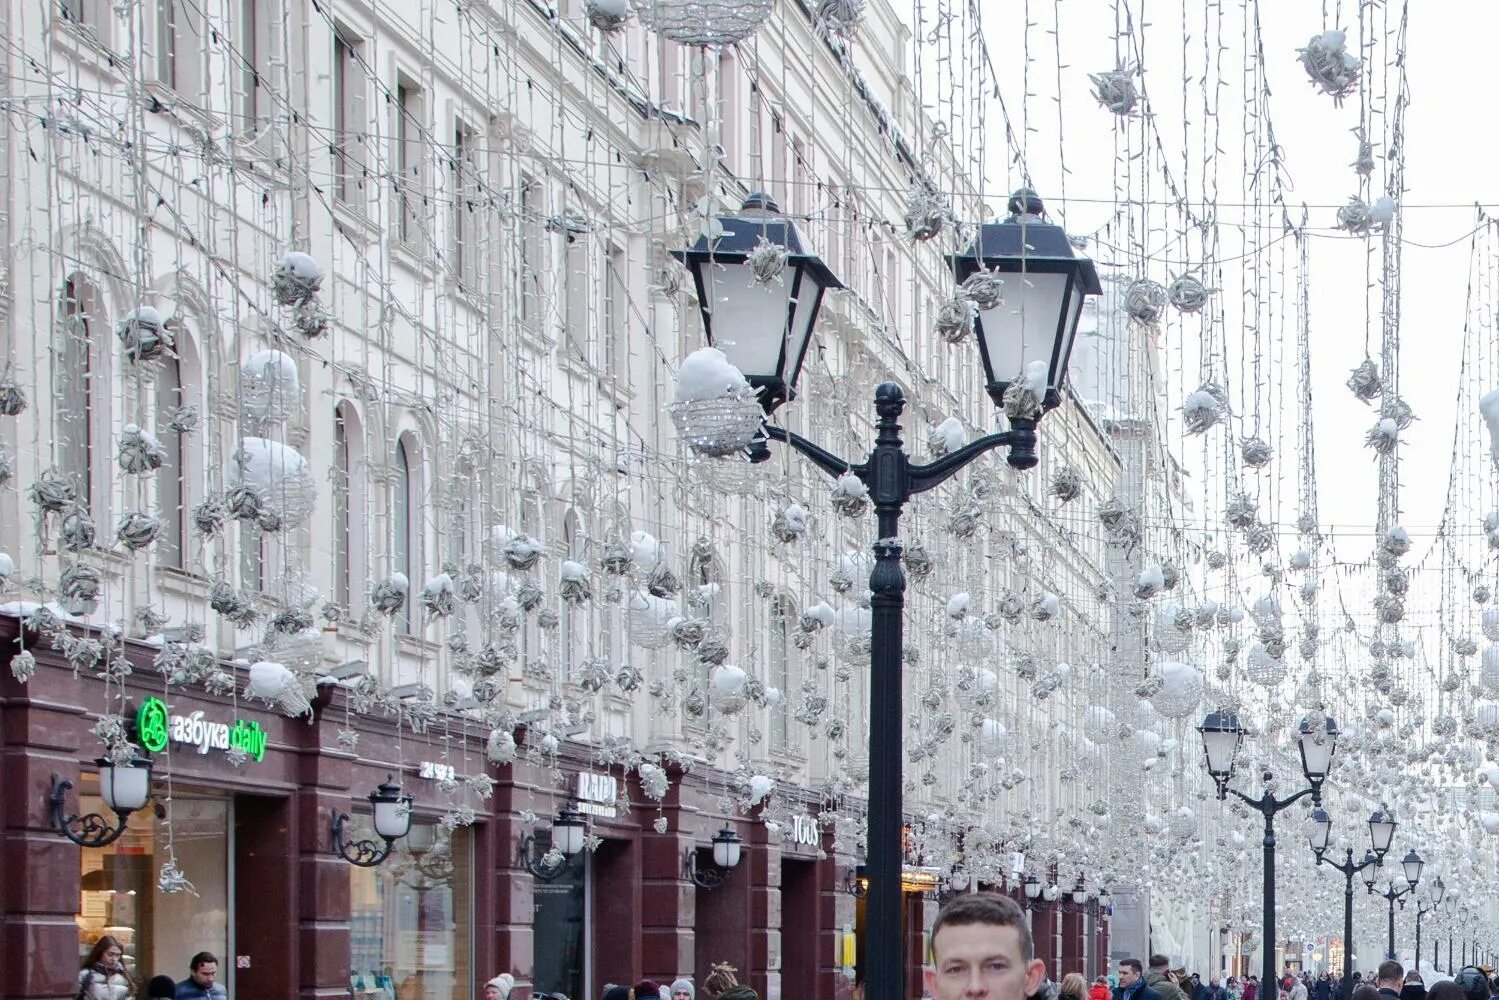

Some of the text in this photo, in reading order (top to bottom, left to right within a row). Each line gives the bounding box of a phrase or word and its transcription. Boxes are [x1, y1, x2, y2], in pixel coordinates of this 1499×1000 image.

[172, 710, 268, 763] азбука daily
[793, 815, 819, 846] TOUS
